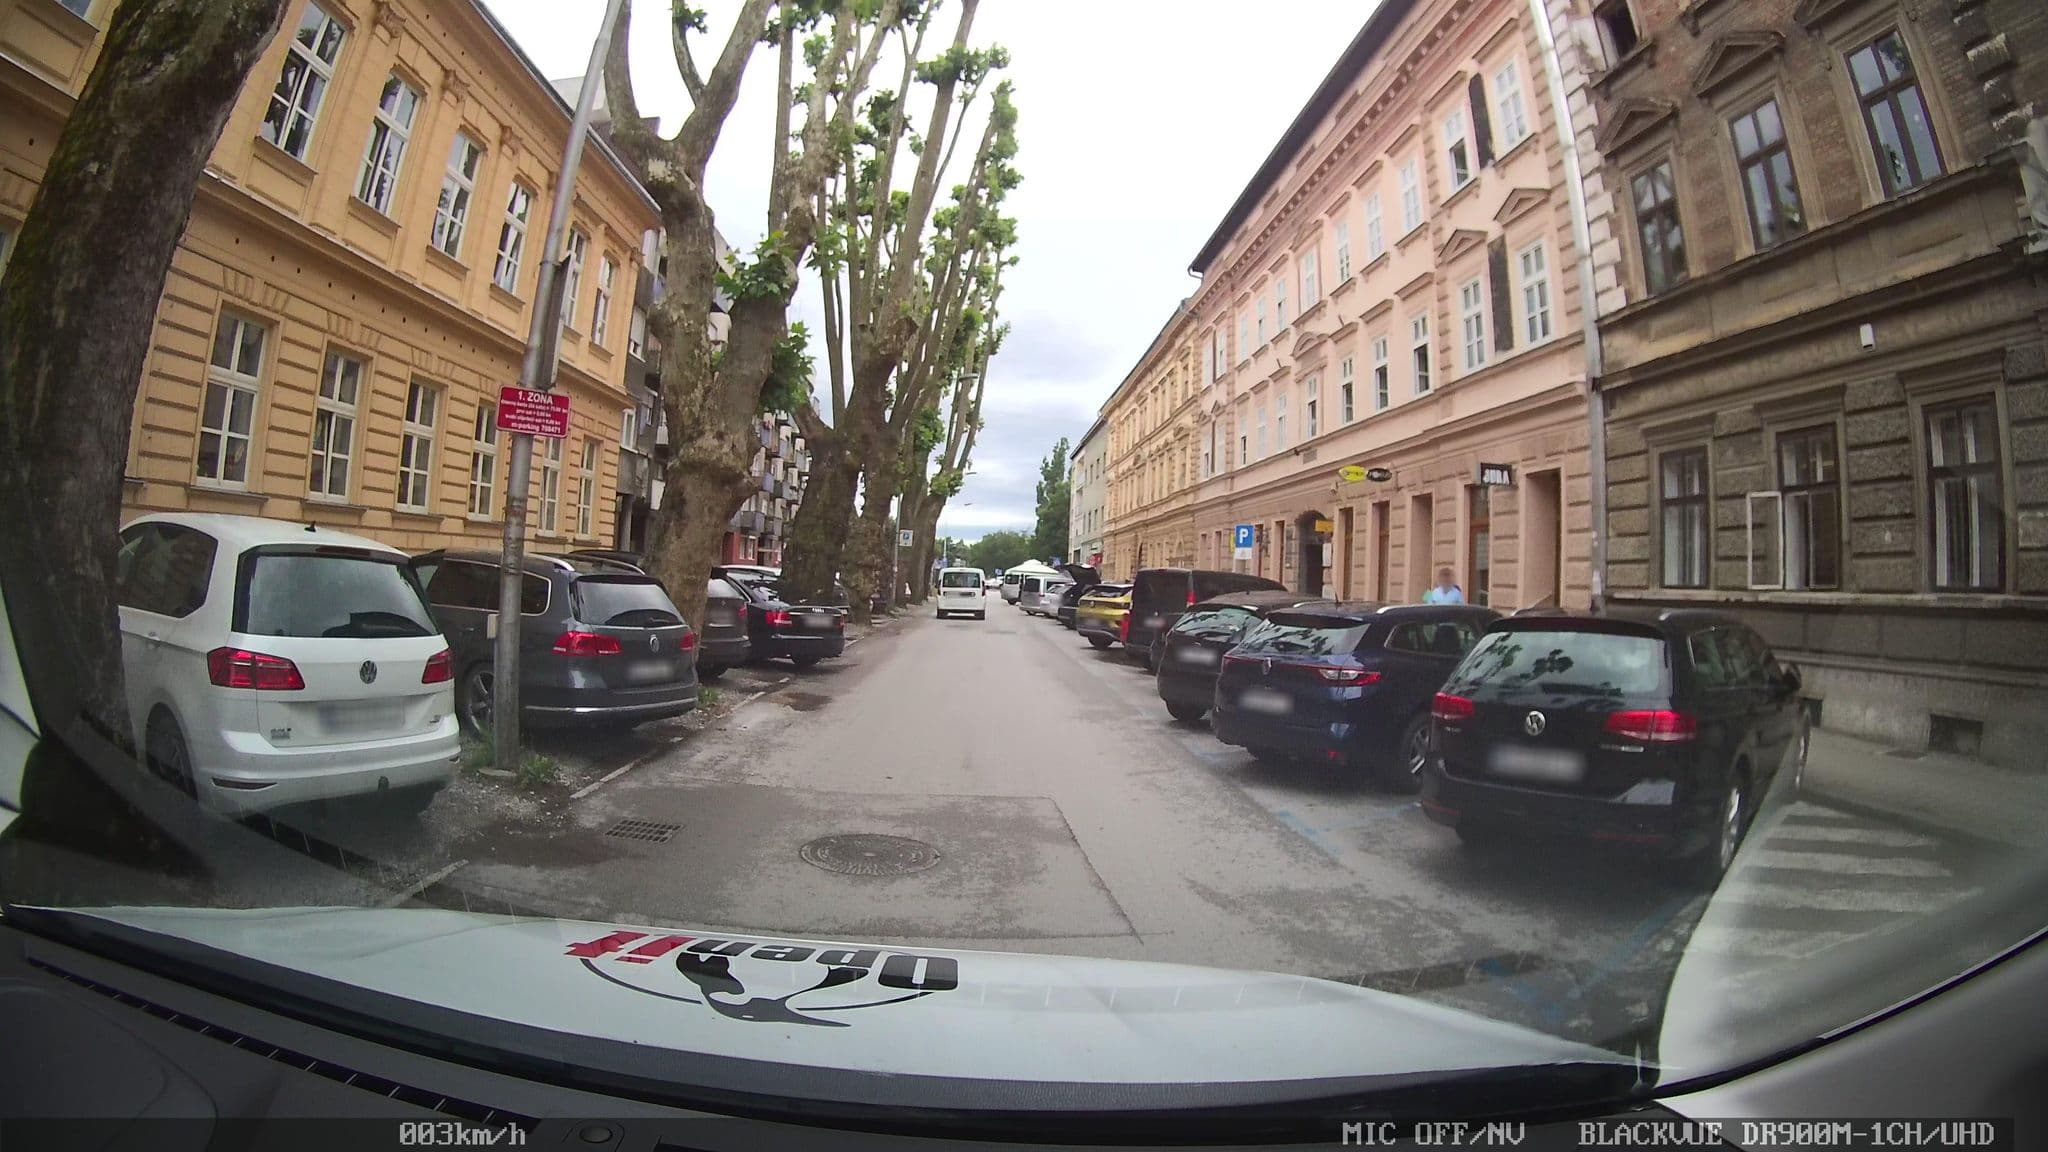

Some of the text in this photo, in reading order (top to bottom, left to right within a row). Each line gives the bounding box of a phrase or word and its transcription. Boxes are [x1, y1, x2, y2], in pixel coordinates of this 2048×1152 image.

[518, 391, 553, 405] 1. ZONA
[1239, 528, 1249, 544] P
